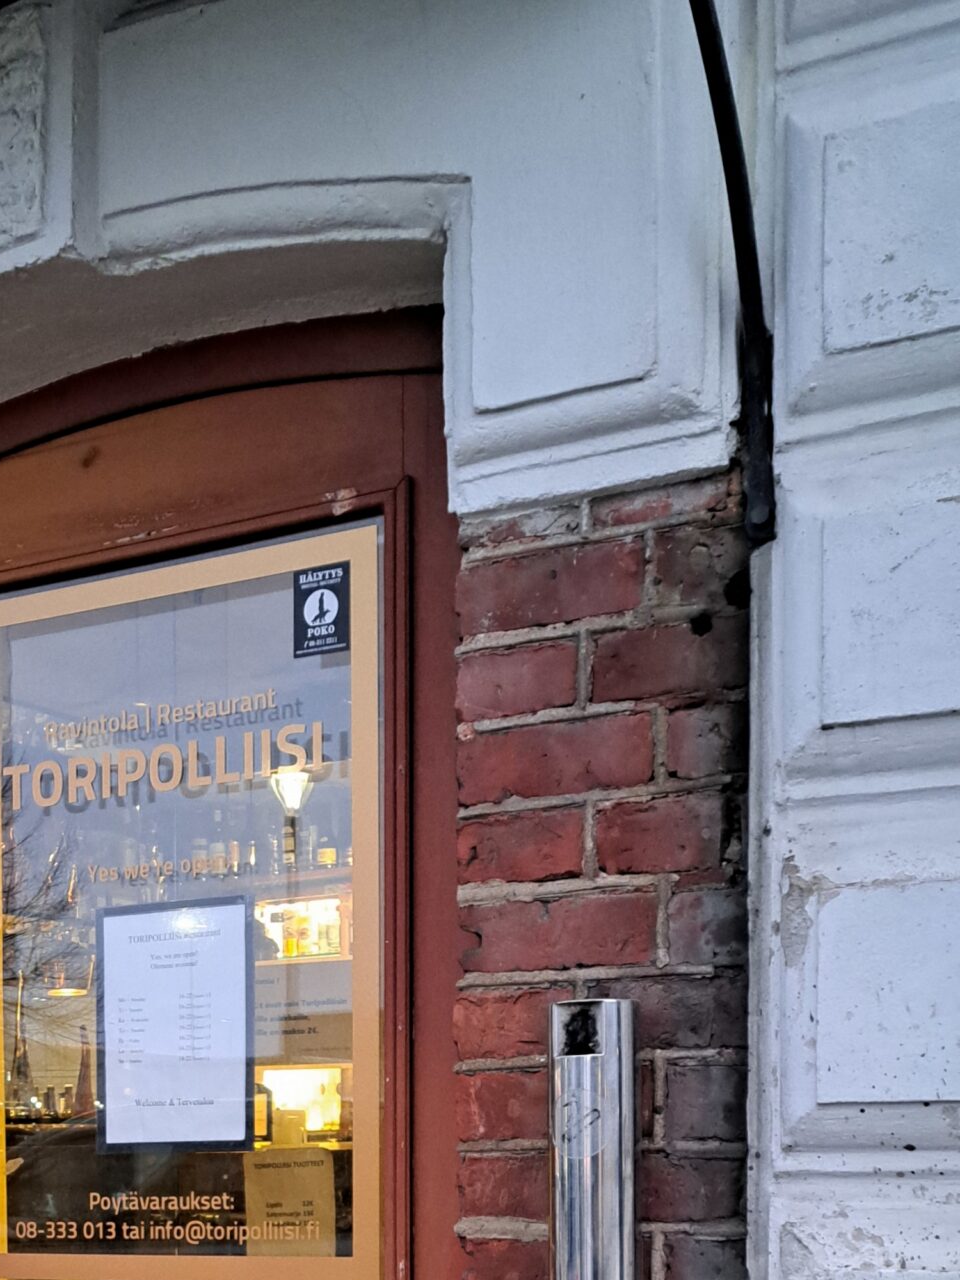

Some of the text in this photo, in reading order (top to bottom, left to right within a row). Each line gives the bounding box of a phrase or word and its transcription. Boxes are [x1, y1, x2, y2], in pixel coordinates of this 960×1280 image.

[299, 567, 343, 584] HÄLYTYS
[307, 624, 336, 638] POKO
[44, 709, 139, 742] Ravintola
[157, 688, 277, 726] Restaurant
[2, 720, 324, 811] TORIPOLLIISI
[87, 864, 119, 883] Yes
[15, 1219, 320, 1245] 08-333 013 tai info@toripolliisi.fi
